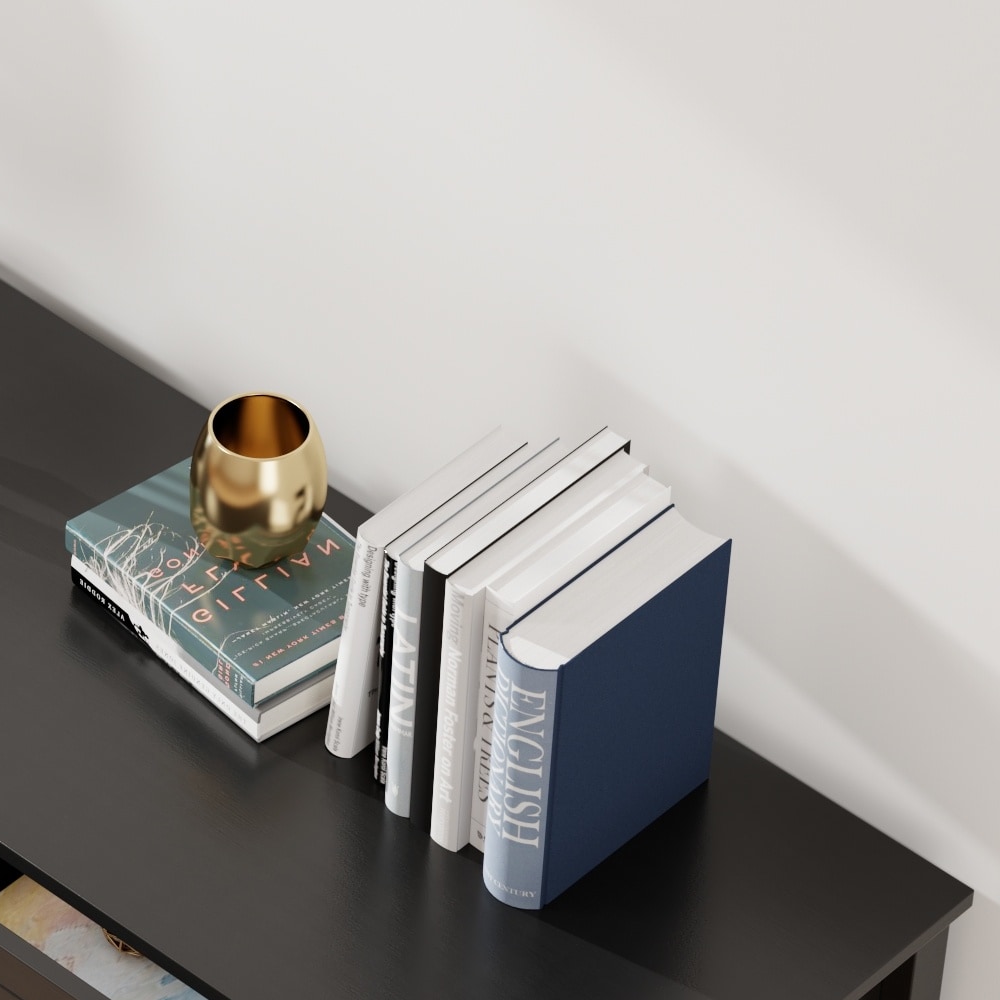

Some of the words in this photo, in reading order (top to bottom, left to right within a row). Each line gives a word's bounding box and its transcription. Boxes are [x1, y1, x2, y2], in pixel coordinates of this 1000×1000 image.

[361, 544, 378, 579] Designing
[358, 592, 369, 609] type
[361, 578, 371, 594] with
[446, 589, 465, 645] Moving
[391, 606, 418, 729] LATIN
[445, 646, 463, 711] Norman
[442, 709, 459, 755] Foster
[440, 755, 452, 776] on
[488, 671, 512, 837] DICTIONARY
[501, 680, 547, 850] ENGLISH
[439, 781, 454, 803] Art
[493, 879, 537, 898] CENTURY
